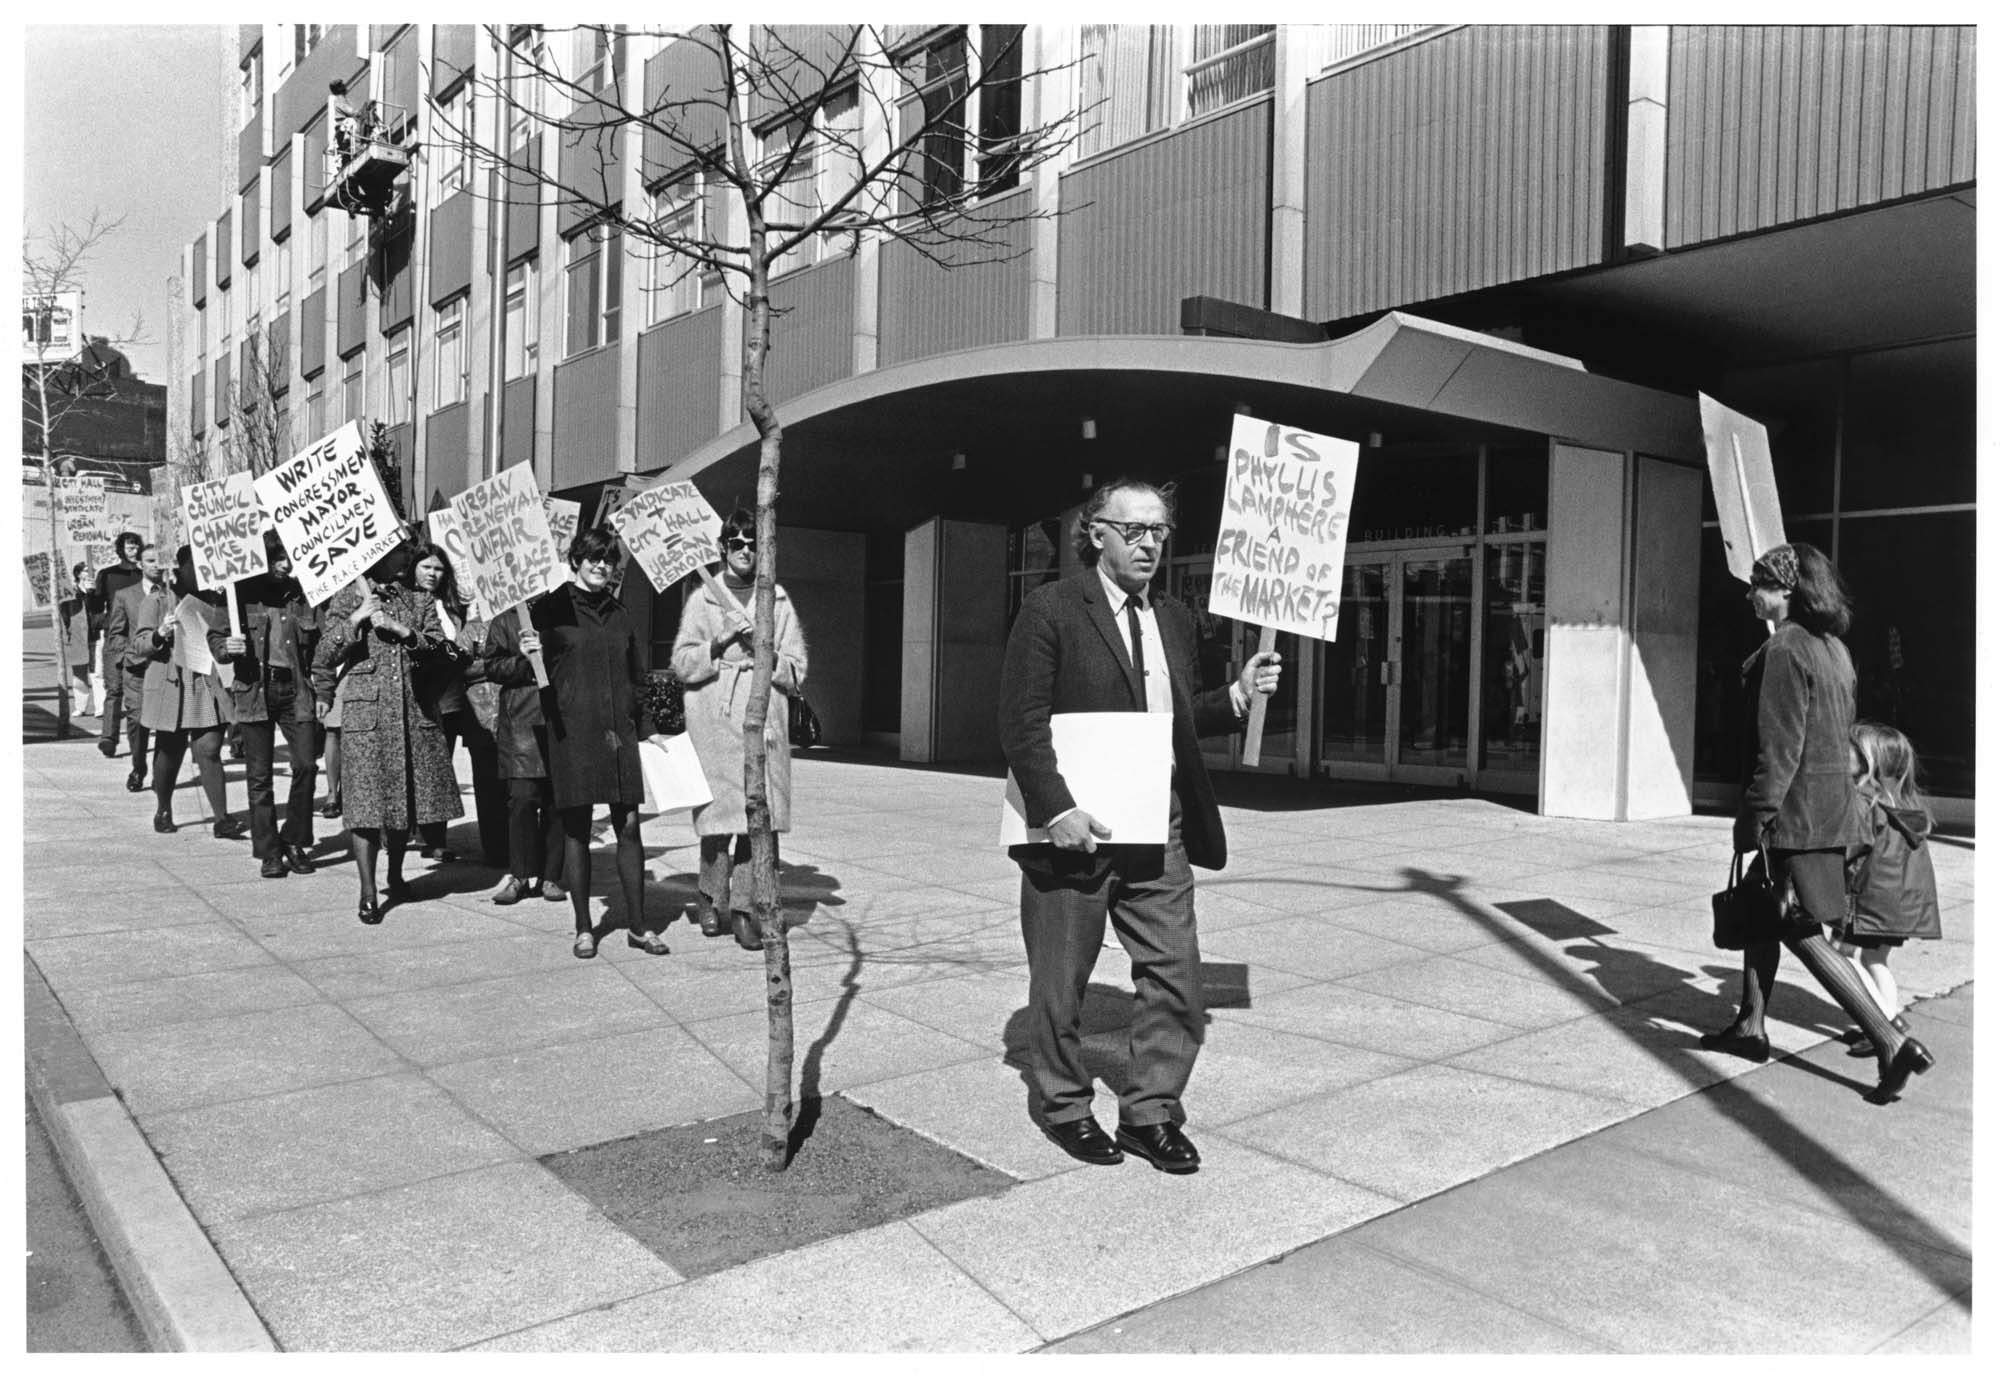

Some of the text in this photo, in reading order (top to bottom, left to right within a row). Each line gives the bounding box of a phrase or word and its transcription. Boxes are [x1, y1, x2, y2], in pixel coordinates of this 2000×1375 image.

[274, 438, 337, 493] WRITE
[1265, 424, 1321, 462] IS
[81, 479, 102, 488] HALL
[191, 479, 228, 503] CITY
[274, 445, 368, 524] CONGRESSMEN
[457, 471, 512, 520] URBAN
[1234, 448, 1337, 508] PHYLLIS
[67, 518, 96, 531] URBAN
[188, 490, 250, 521] COUNCIL
[292, 493, 375, 562] COUNCILMEN
[298, 482, 361, 536] MAYOR
[462, 491, 540, 538] RENEWAL
[616, 484, 699, 531] SYNDICATE
[1228, 476, 1347, 544] LAMPHERE
[192, 512, 259, 548] CHANGE
[204, 541, 243, 563] PIKE
[308, 513, 378, 577] SAVE
[361, 526, 402, 563] MARKET
[471, 517, 538, 565] UNFAIR
[629, 507, 711, 554] CITY HALL
[1266, 526, 1281, 544] A
[1364, 524, 1447, 542] BUILDING
[198, 549, 265, 584] PLAZA
[477, 570, 507, 601] PIKE
[510, 539, 551, 583] PLACE
[650, 532, 713, 576] URBAN
[654, 547, 719, 589] REMOVA
[1216, 529, 1332, 582] FRIEND OF
[488, 566, 552, 616] MARKET
[1214, 572, 1242, 597] THE
[1240, 573, 1338, 639] MARKET?
